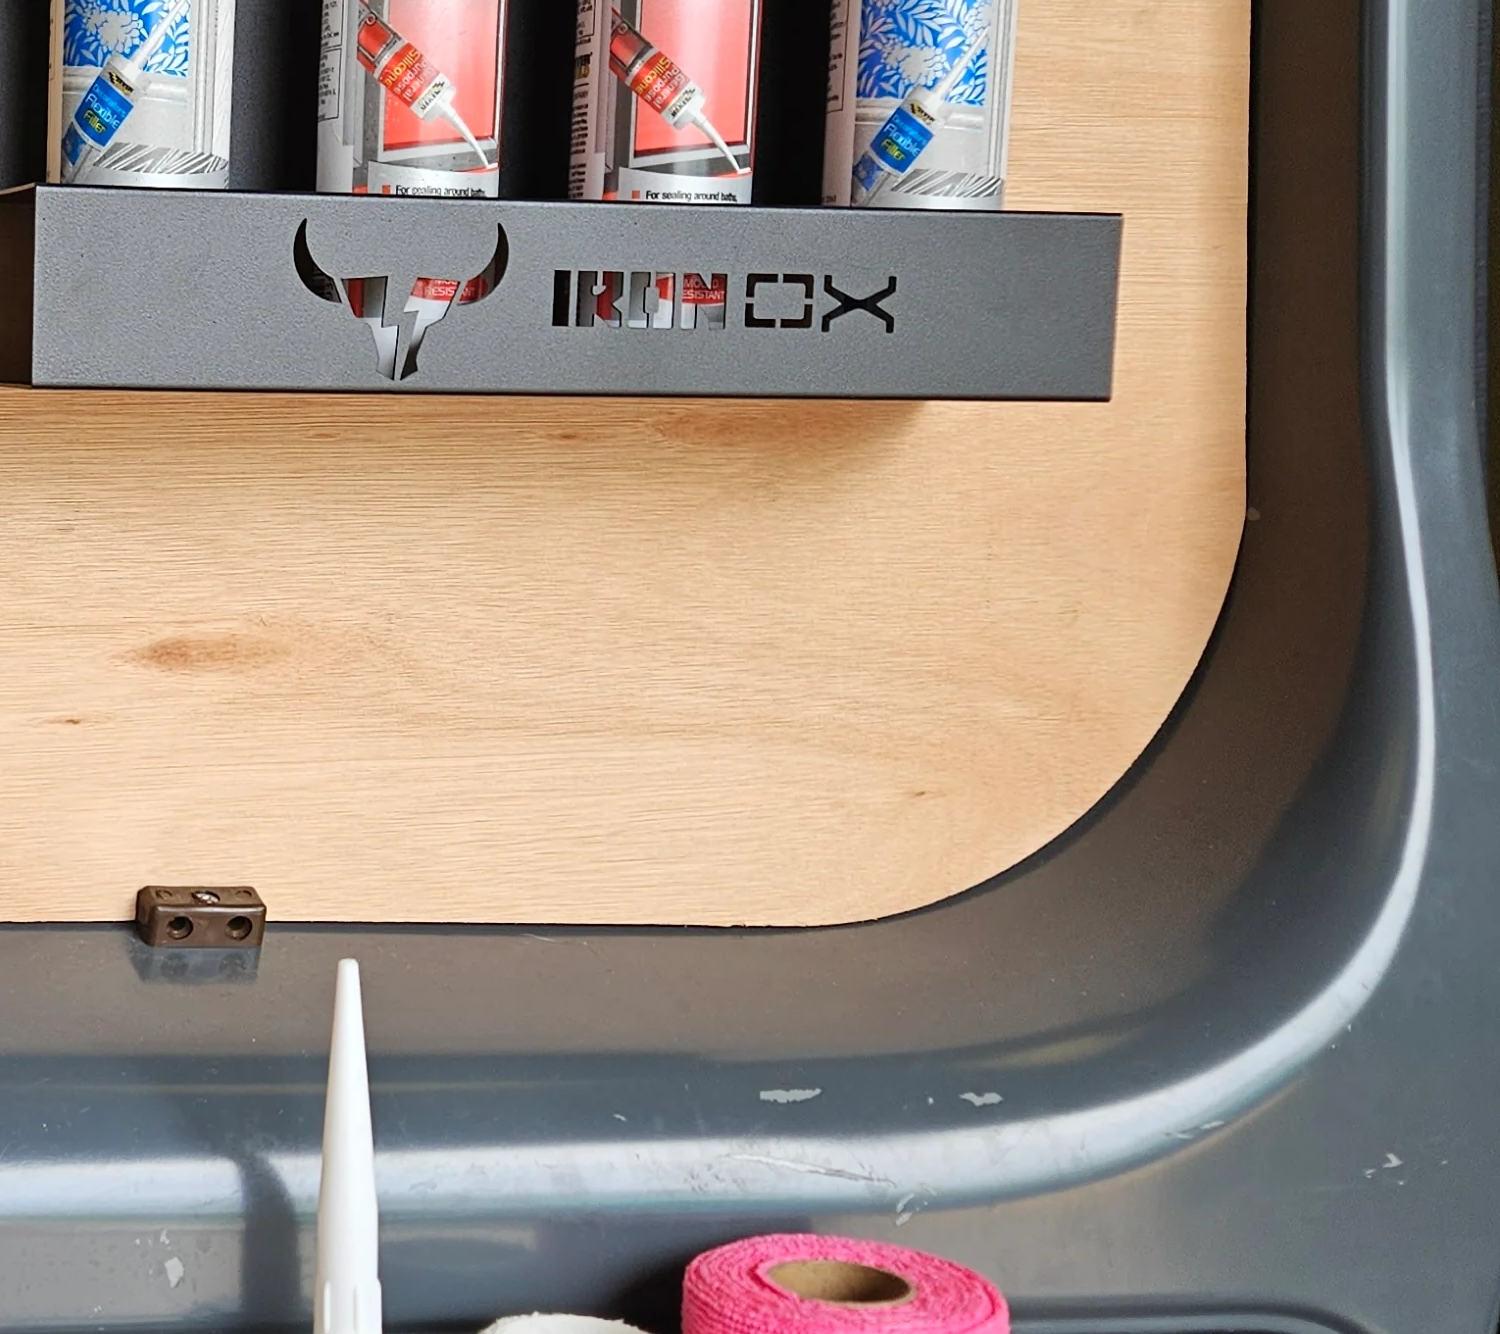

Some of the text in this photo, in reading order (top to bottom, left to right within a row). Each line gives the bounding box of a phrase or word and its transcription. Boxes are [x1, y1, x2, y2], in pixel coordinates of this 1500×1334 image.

[646, 190, 660, 200] For
[683, 289, 724, 300] ESISTANT
[552, 269, 897, 334] IRON OX
